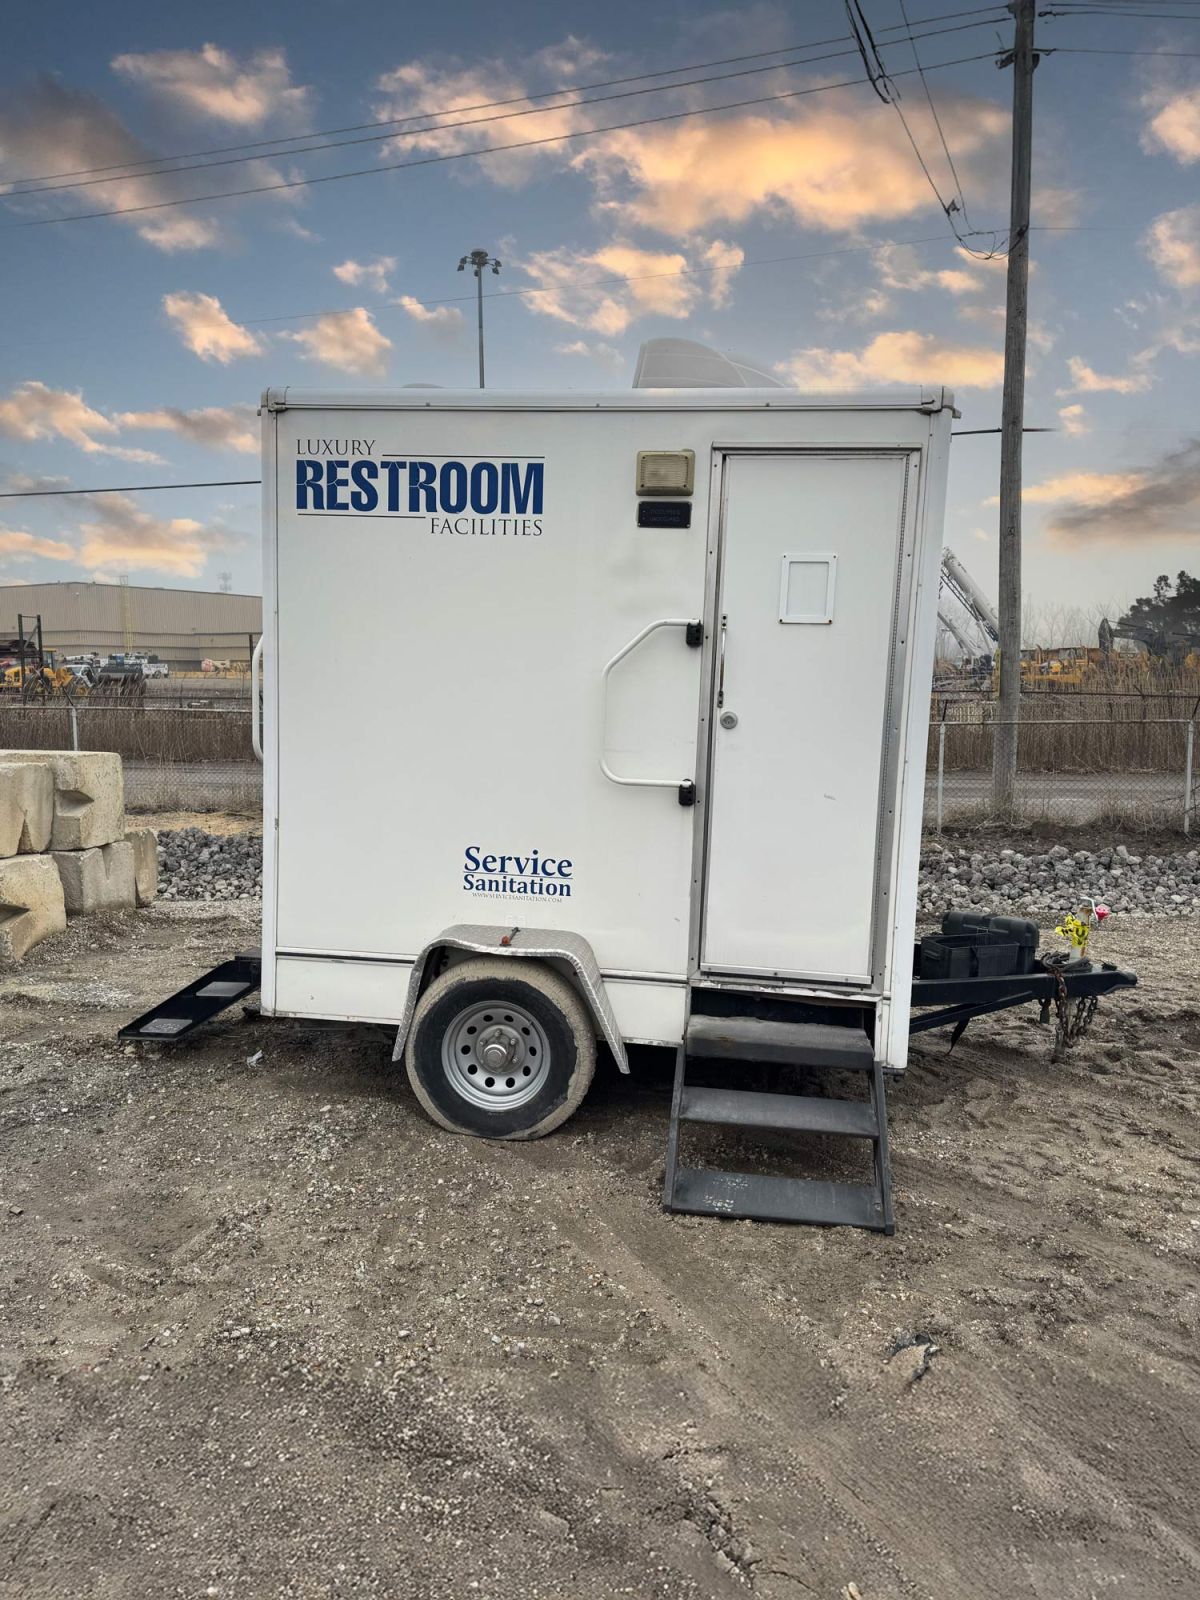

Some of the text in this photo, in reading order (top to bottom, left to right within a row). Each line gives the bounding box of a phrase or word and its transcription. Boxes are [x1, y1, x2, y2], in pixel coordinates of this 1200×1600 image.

[296, 439, 376, 456] LUXURY
[296, 459, 545, 515] RESTROOM
[430, 517, 543, 536] FACILITIES
[464, 846, 573, 877] Service
[463, 874, 571, 897] Sanitation
